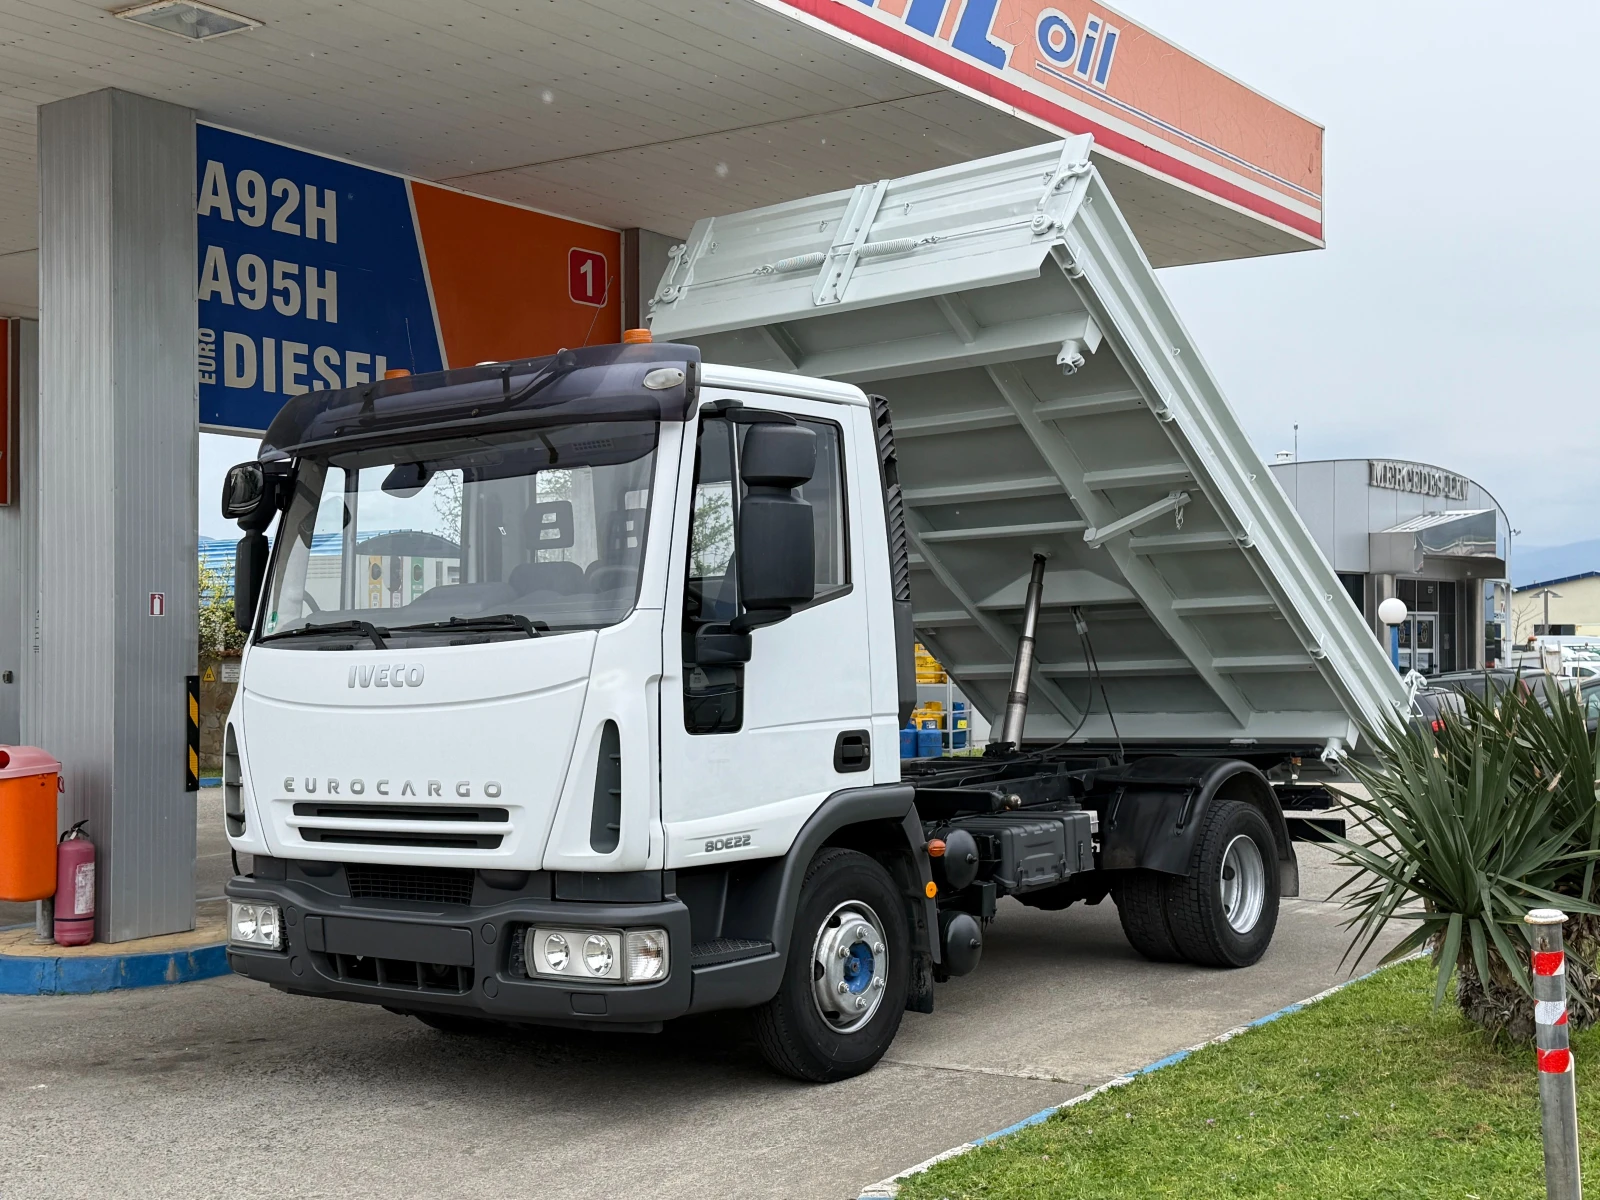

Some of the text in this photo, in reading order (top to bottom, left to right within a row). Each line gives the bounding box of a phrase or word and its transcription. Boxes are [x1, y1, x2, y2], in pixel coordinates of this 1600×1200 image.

[1036, 13, 1118, 87] oil
[197, 159, 337, 244] A92H
[198, 245, 338, 323] A95H
[580, 259, 593, 297] 1
[199, 327, 216, 384] EURO
[348, 663, 425, 688] IVECO
[283, 777, 502, 798] EUROCARGO
[704, 834, 751, 852] 80E22
